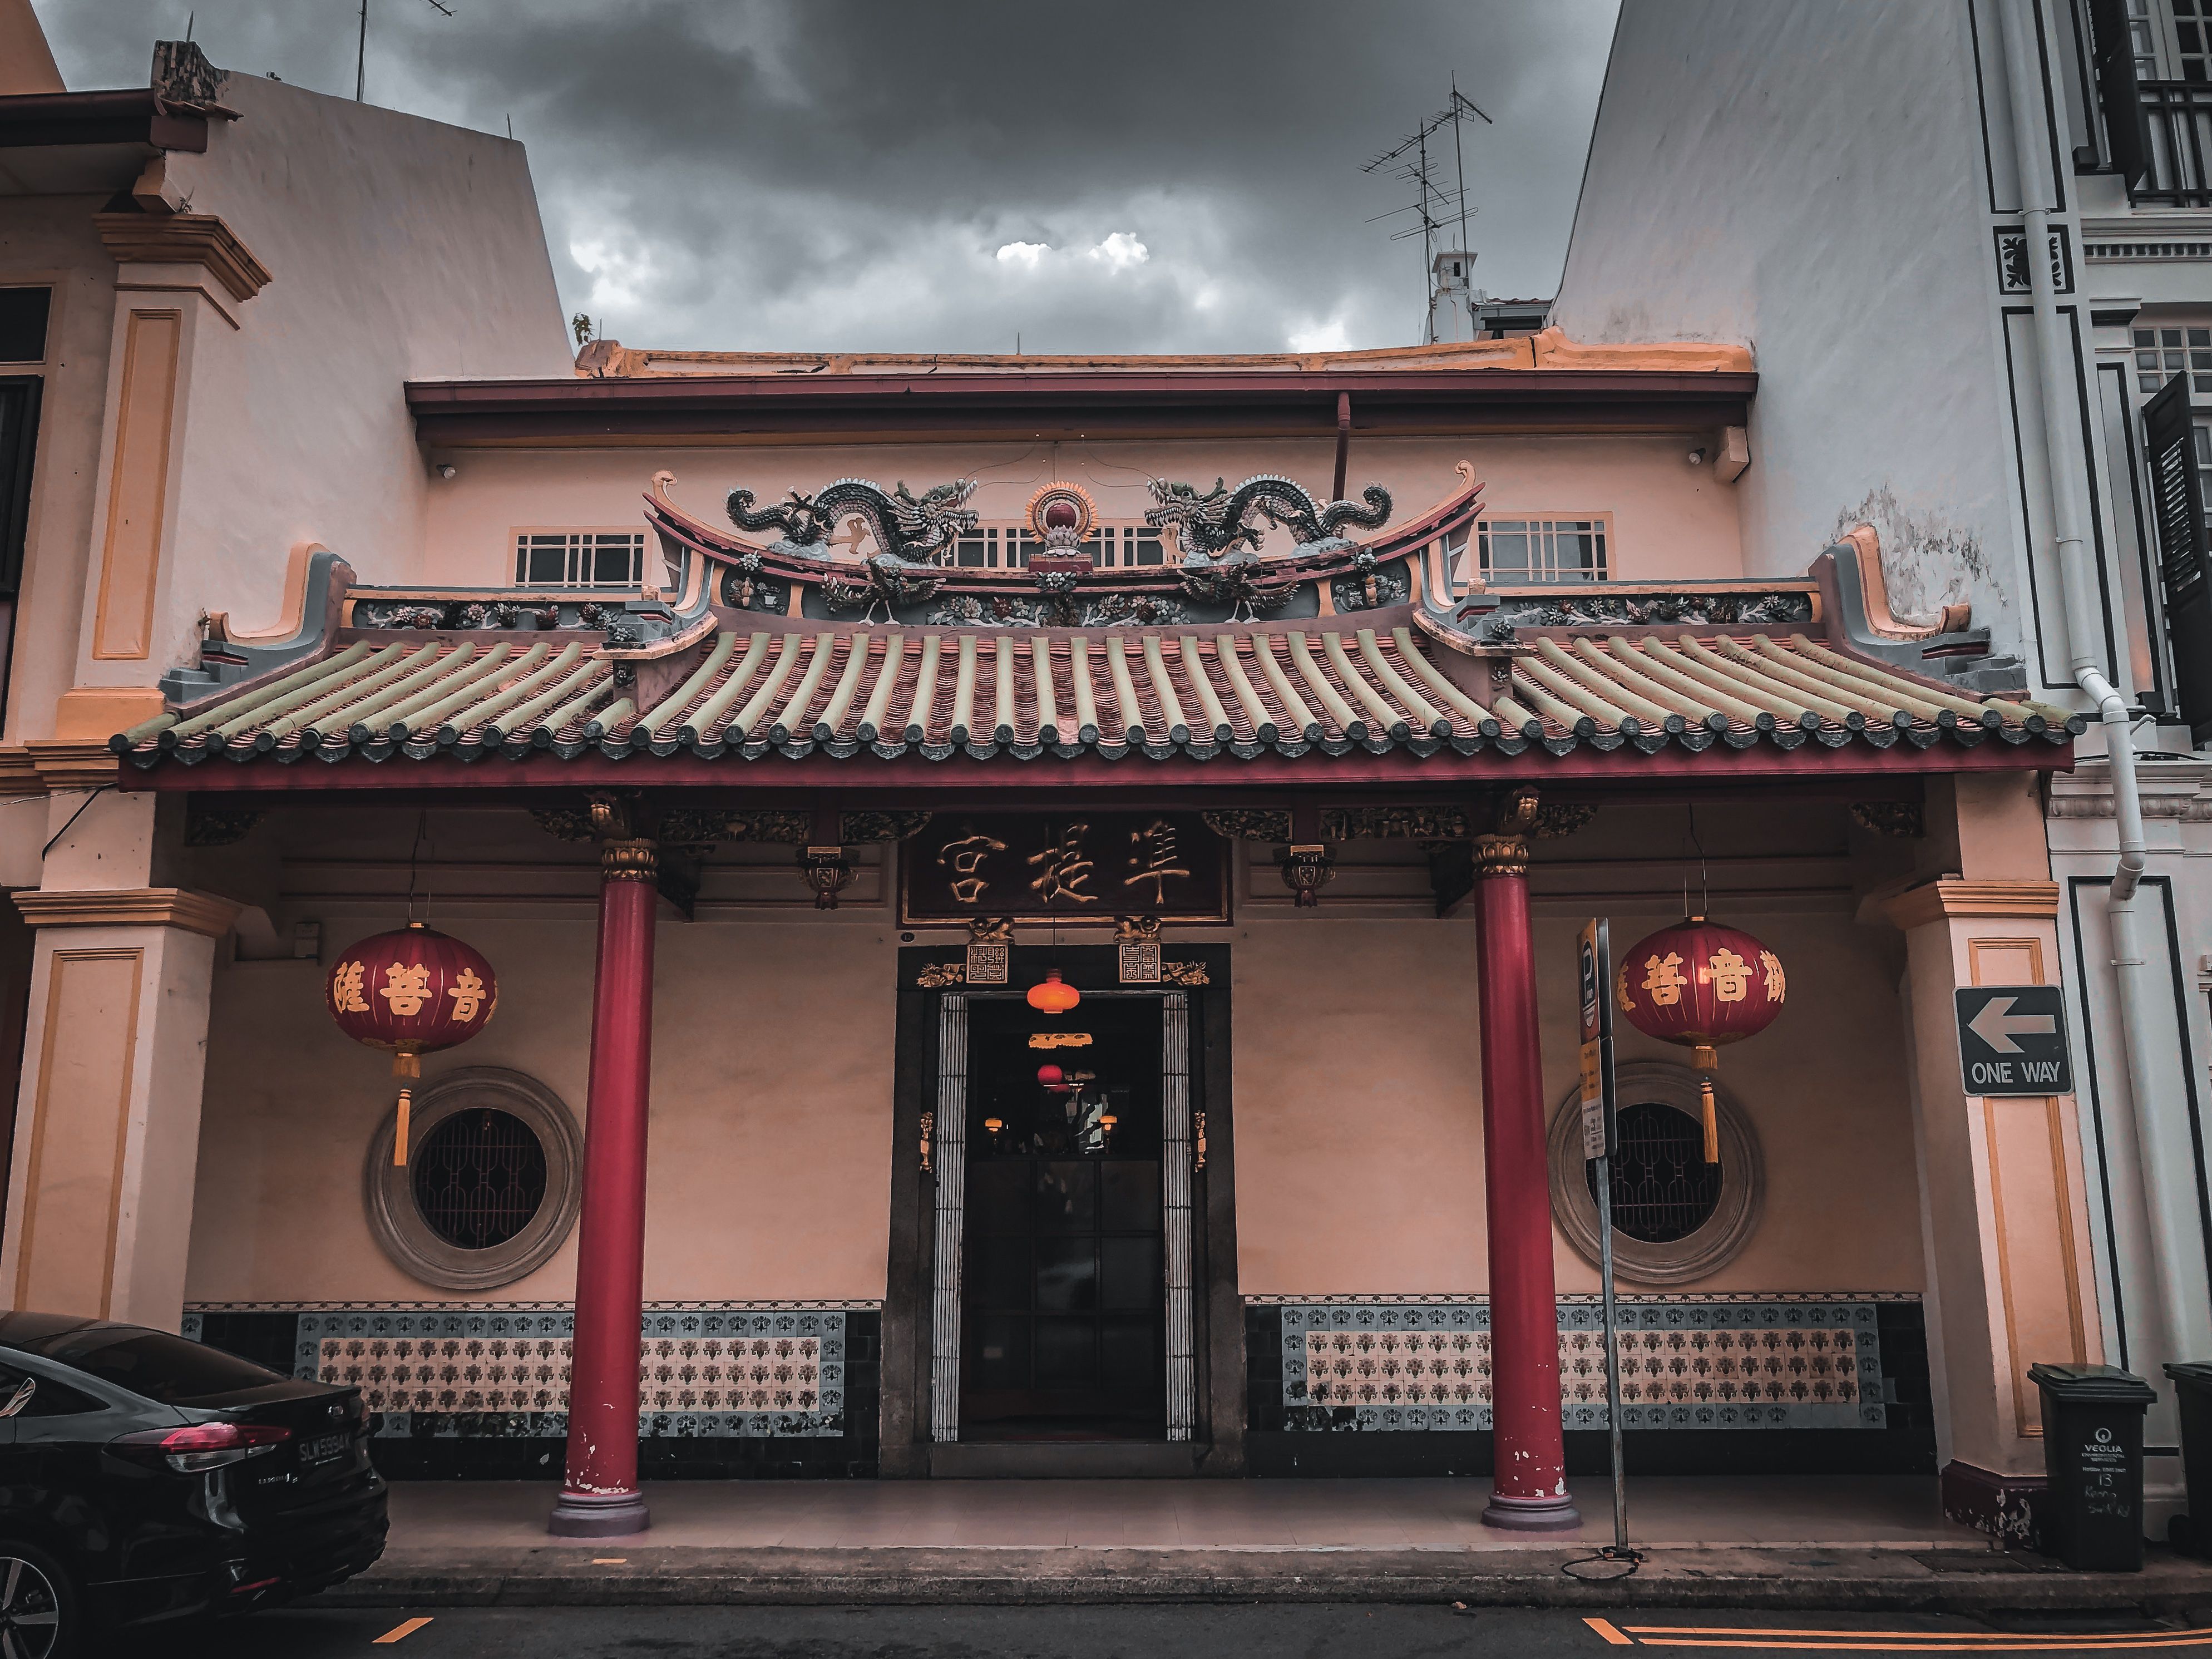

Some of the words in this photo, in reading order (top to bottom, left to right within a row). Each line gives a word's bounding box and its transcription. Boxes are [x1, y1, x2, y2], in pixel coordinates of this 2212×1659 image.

[1972, 1062, 2013, 1084] ONE
[2022, 1061, 2061, 1083] WAY
[2084, 1444, 2122, 1453] VEOLIA
[2099, 1473, 2112, 1487] 13
